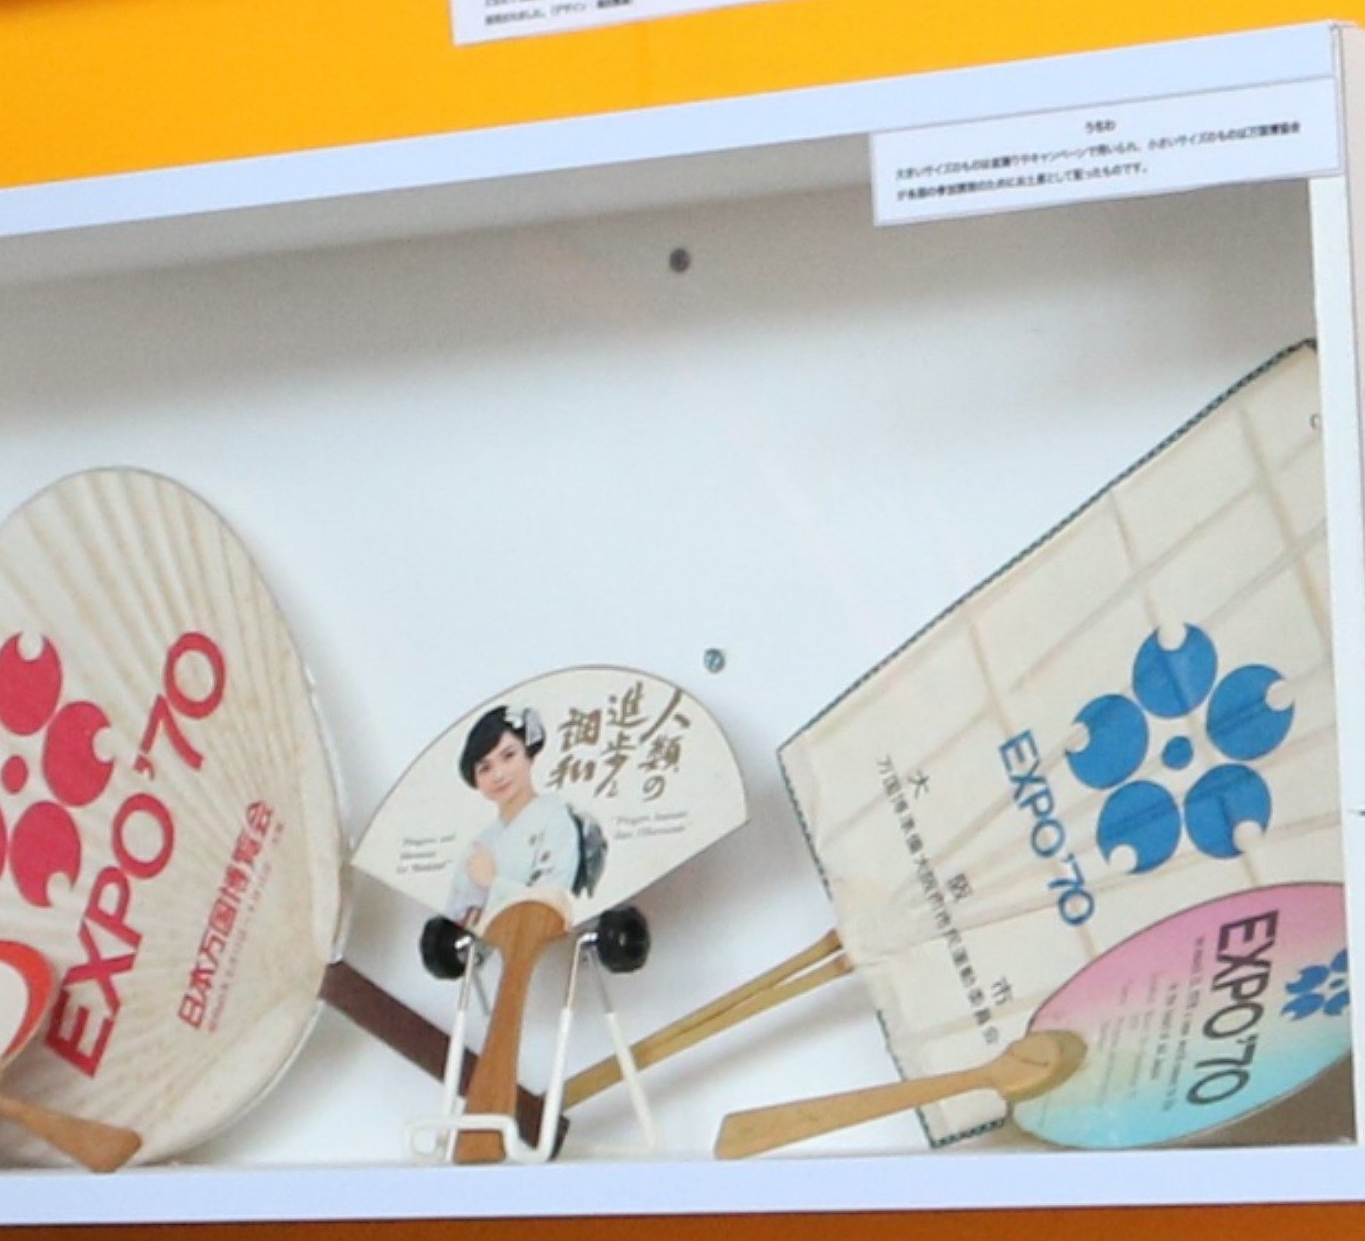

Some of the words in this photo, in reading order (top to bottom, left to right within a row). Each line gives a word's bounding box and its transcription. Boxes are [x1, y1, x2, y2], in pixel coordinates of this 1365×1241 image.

[176, 799, 273, 1031] 日本万国博覧会
[1185, 909, 1279, 1106] EXPO'70
